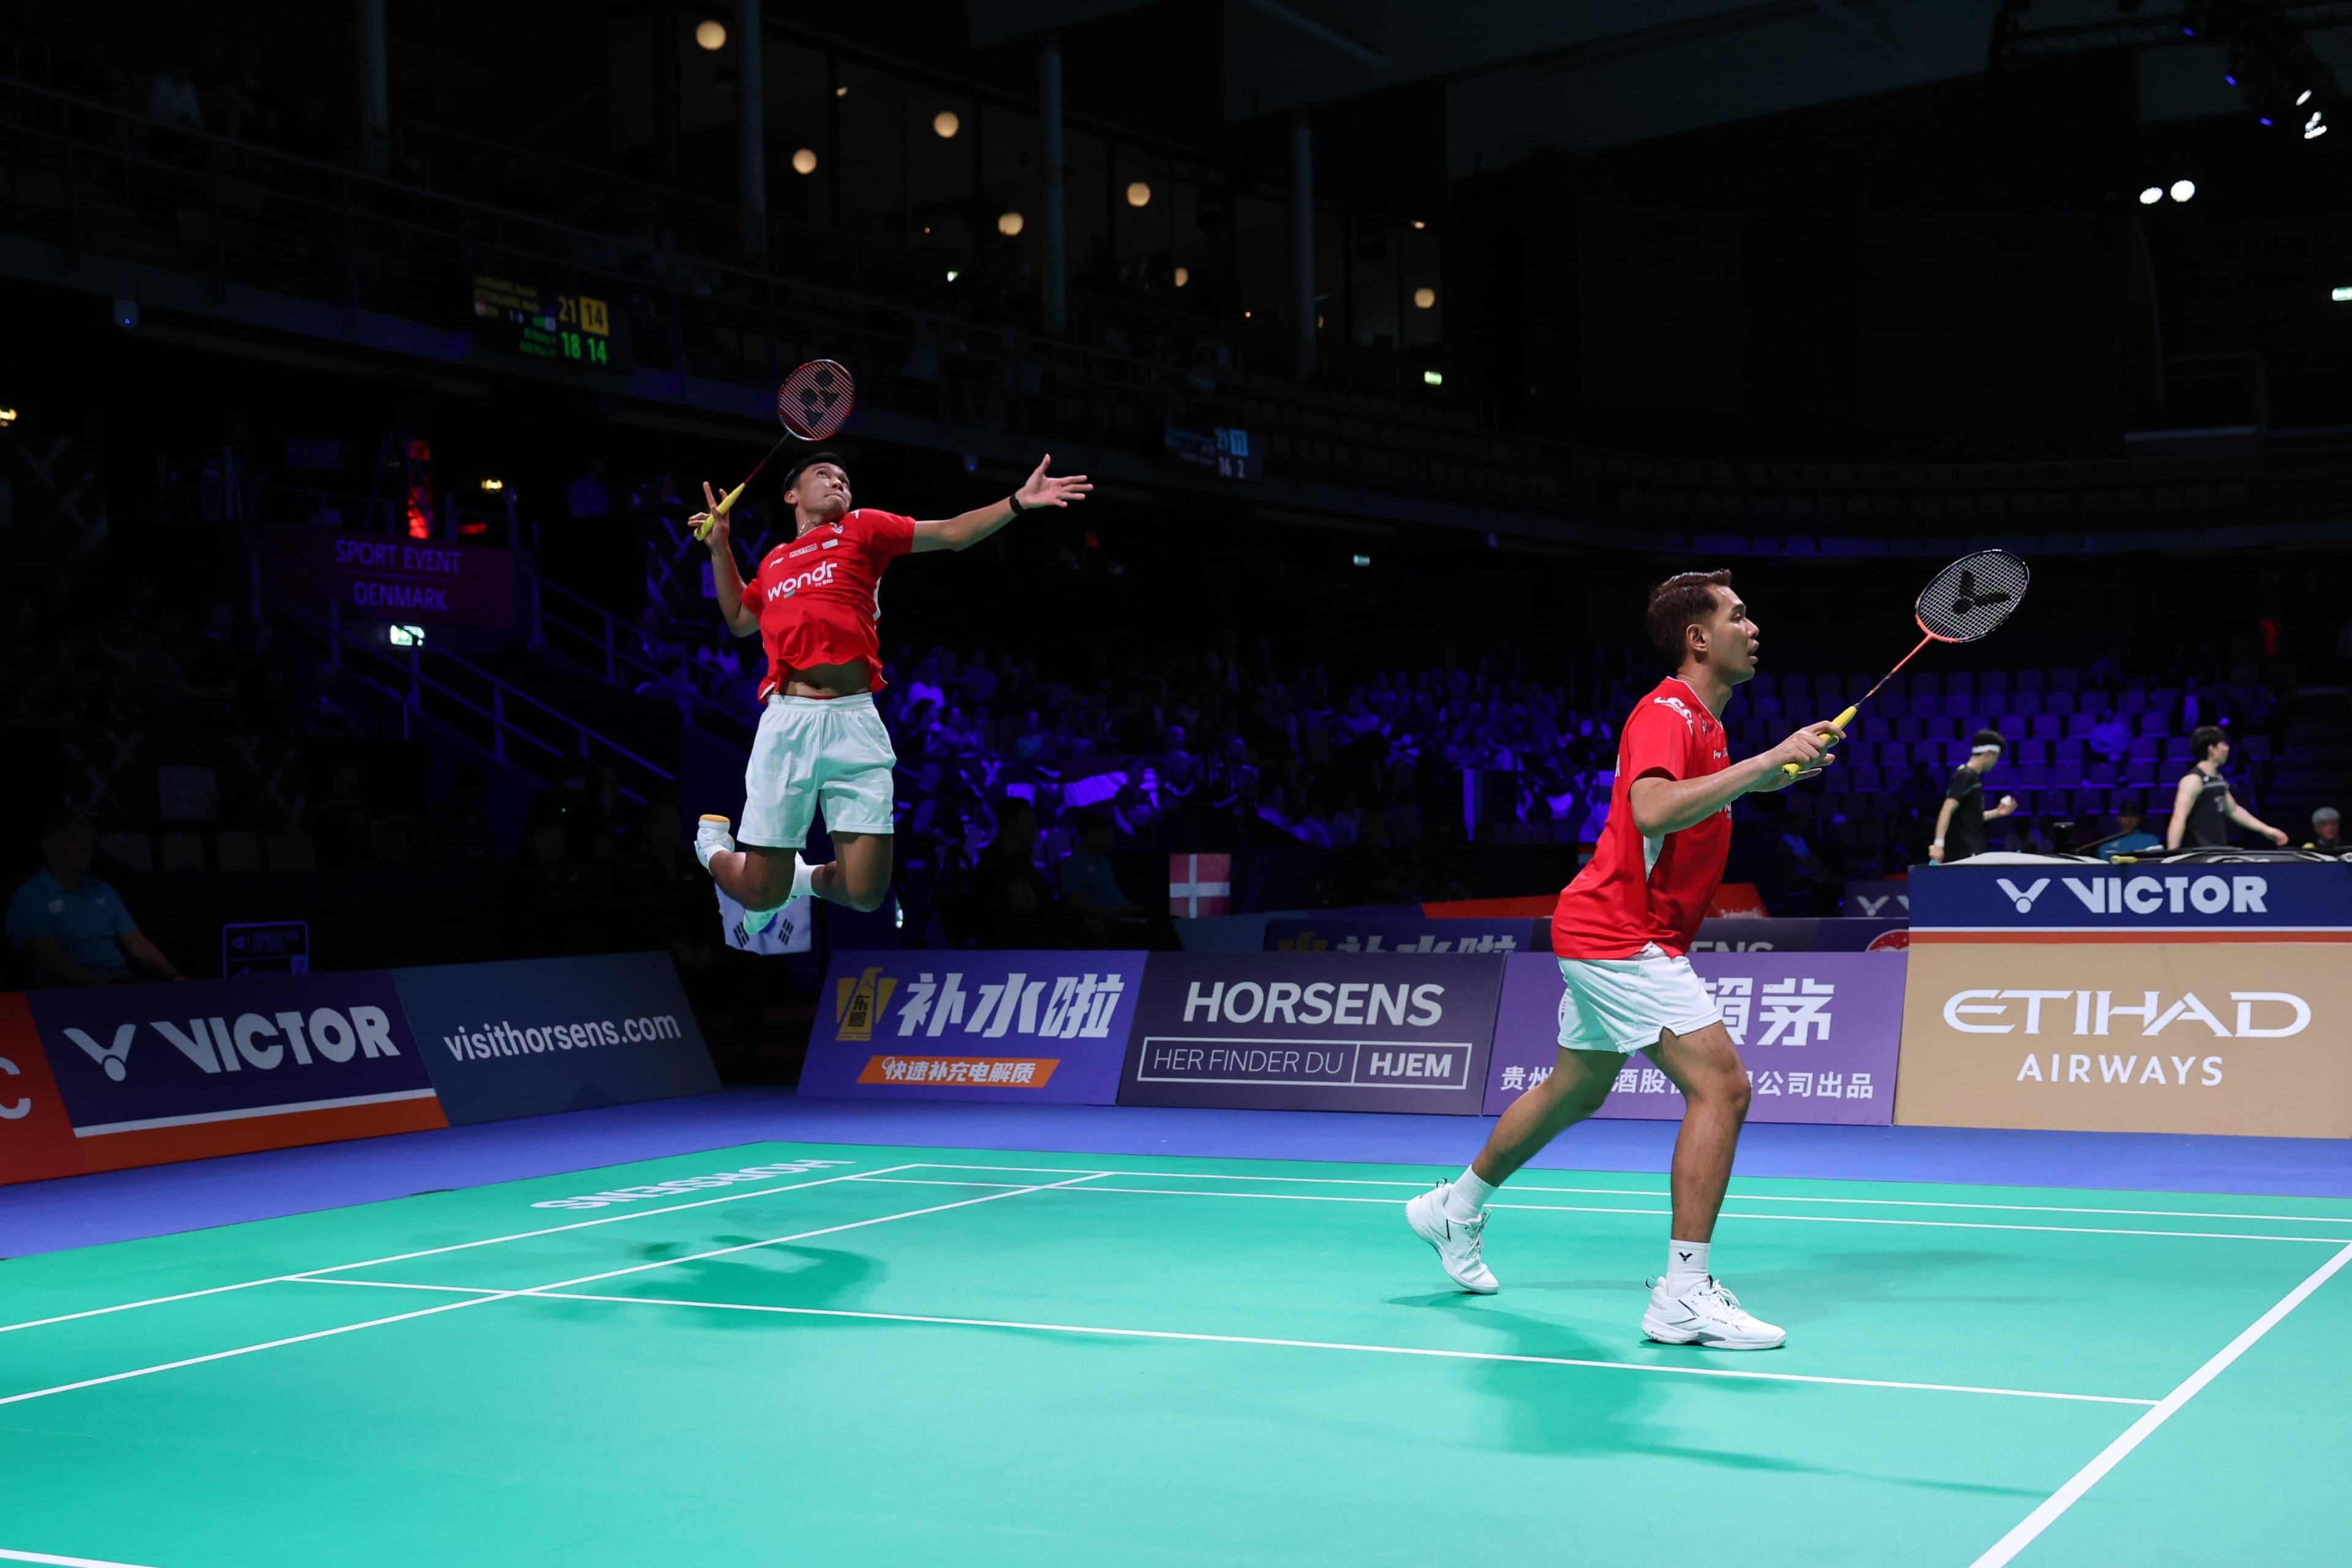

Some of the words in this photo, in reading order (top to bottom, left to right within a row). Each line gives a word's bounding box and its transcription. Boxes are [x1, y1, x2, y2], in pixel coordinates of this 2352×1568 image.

[558, 296, 577, 324] 21
[561, 331, 581, 360] 18
[587, 337, 608, 365] 14
[335, 539, 397, 568] SPORT
[403, 547, 462, 573] EVENT
[353, 581, 448, 611] DENMARK
[767, 561, 837, 601] wondr
[2061, 875, 2268, 914] VICTOR
[897, 973, 1125, 1039] 补水啦
[1183, 981, 1446, 1027] HORSENS
[1942, 989, 2312, 1038] ETIHAD
[150, 1005, 401, 1074] VICTOR
[443, 1014, 682, 1061] visithorsens.com
[884, 1060, 1036, 1084] 快速补充电解质
[1153, 1049, 1204, 1071] HER
[1208, 1050, 1300, 1073] FINDER
[1305, 1052, 1344, 1074] DU
[1370, 1052, 1452, 1077] HJEM
[2016, 1053, 2223, 1087] AIRWAYS
[530, 1159, 857, 1210] HORSENS
